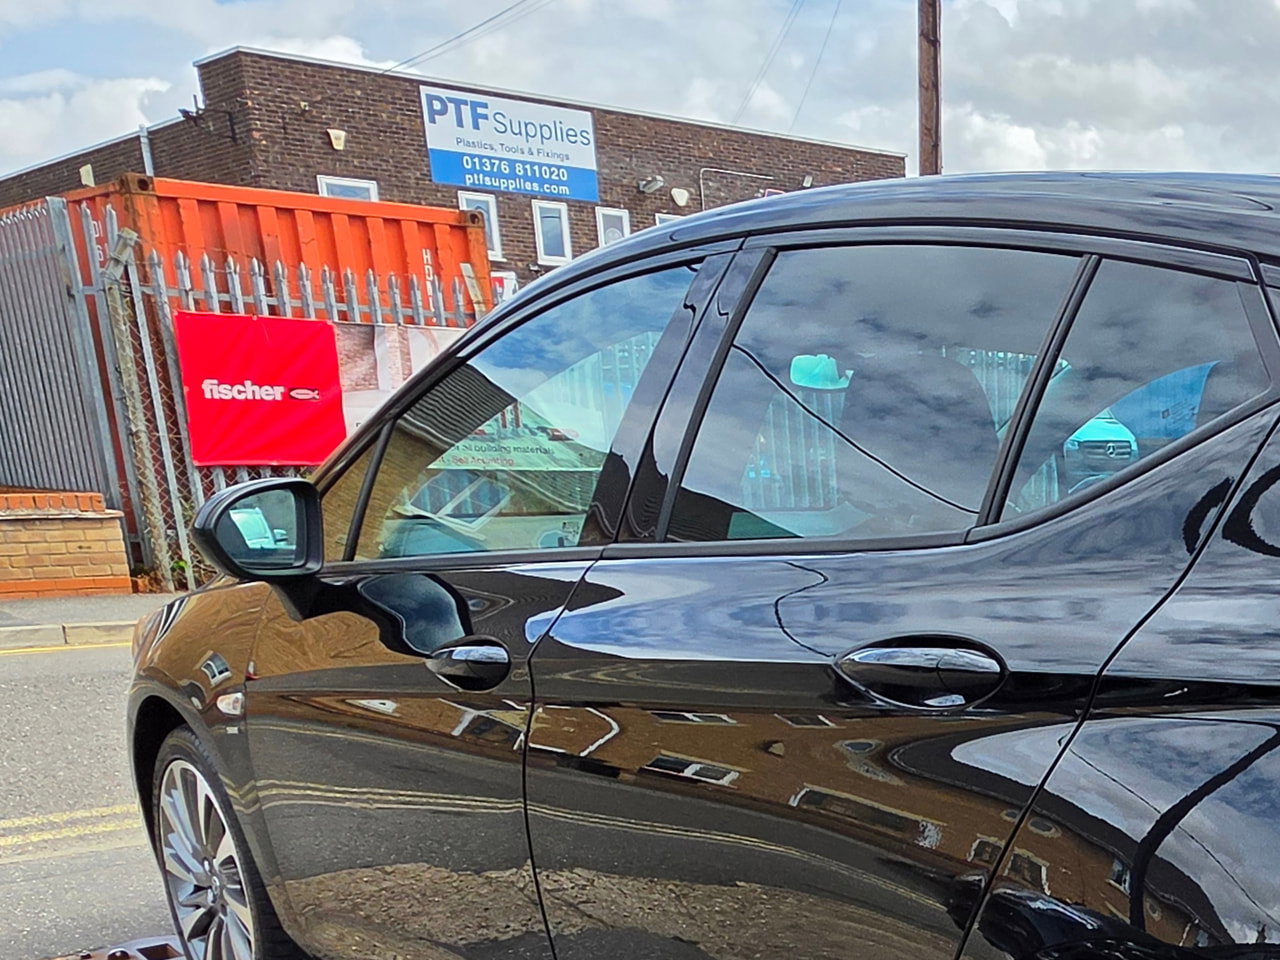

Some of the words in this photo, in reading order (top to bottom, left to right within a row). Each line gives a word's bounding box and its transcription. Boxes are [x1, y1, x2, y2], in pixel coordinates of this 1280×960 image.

[425, 93, 489, 131] PTF
[492, 111, 591, 146] Supplies
[456, 137, 497, 152] Plastics,
[500, 143, 525, 155] Tools
[527, 147, 534, 156] &
[537, 149, 570, 162] Fixings
[463, 155, 510, 174] 01376
[515, 163, 568, 181] 811020
[465, 173, 570, 196] ptfsupplies.com
[202, 379, 285, 401] fischer
